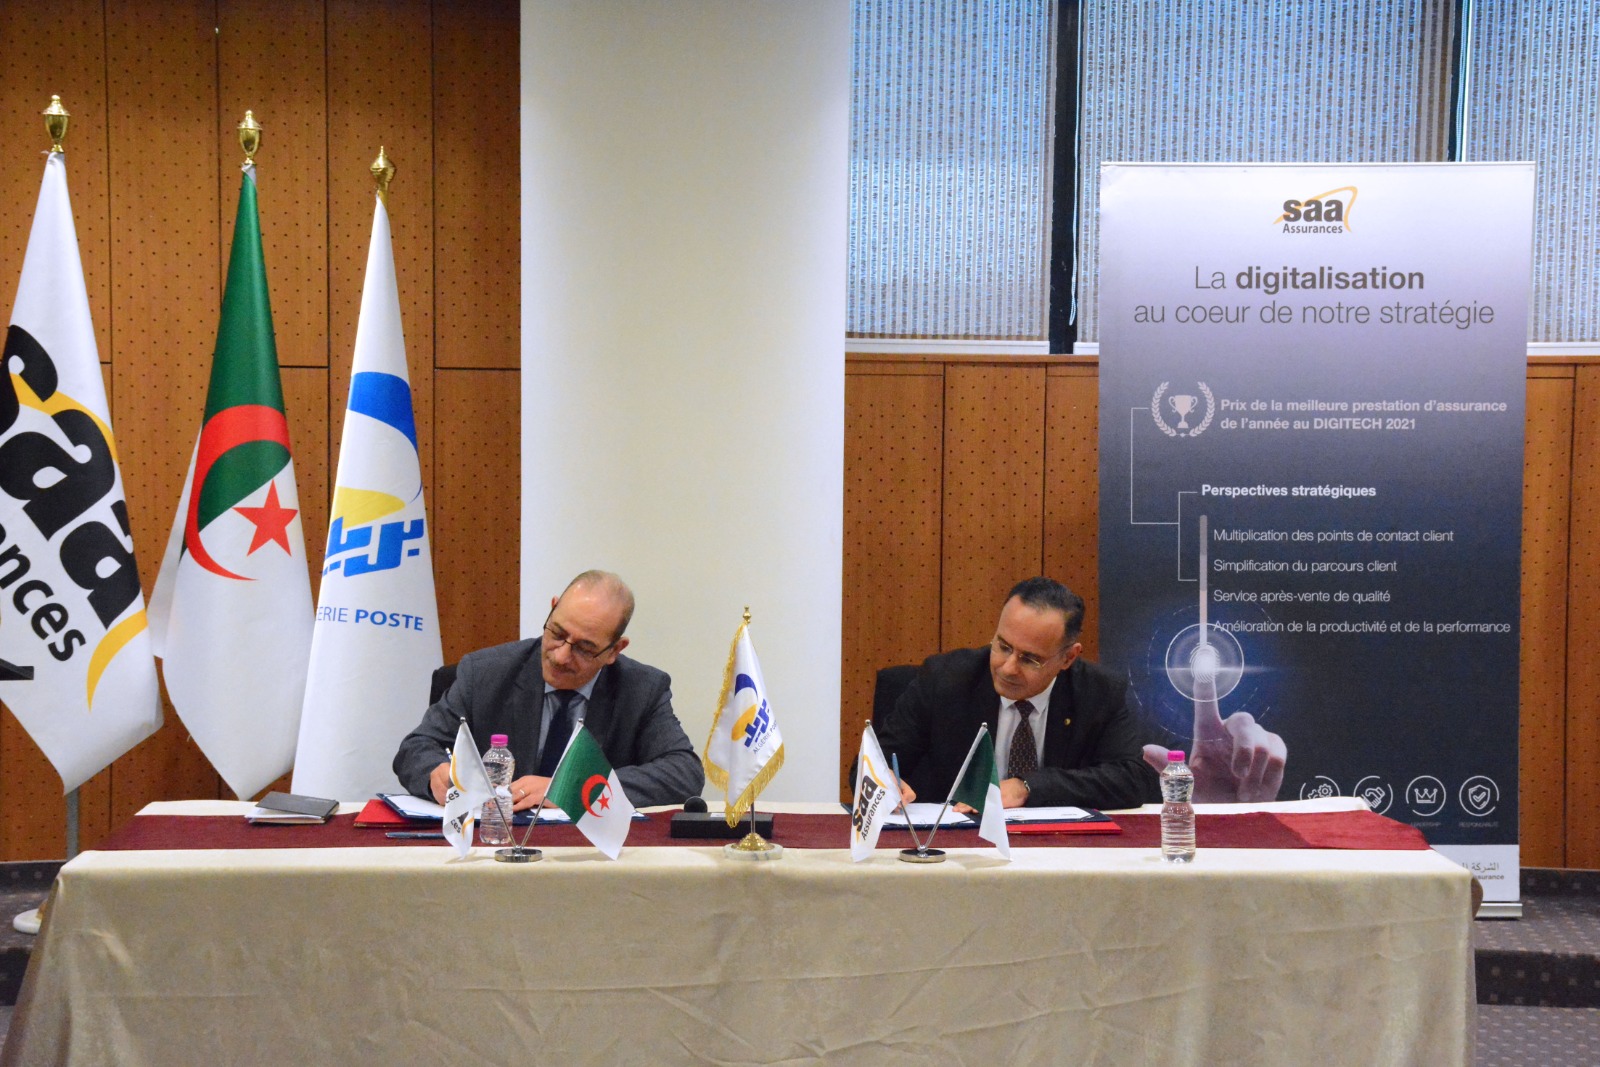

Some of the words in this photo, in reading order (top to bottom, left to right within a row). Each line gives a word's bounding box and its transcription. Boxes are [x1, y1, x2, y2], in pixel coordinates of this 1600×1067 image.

[1283, 199, 1343, 222] saa
[1283, 223, 1343, 234] Assurances
[1195, 266, 1226, 290] La
[1235, 266, 1425, 296] digitalisation
[1133, 304, 1165, 324] au
[1174, 304, 1250, 324] coeur
[1259, 300, 1293, 324] de
[1302, 302, 1371, 324] notre
[1379, 300, 1495, 330] stratégie
[1220, 399, 1247, 411] Prix
[1250, 399, 1268, 411] de
[1271, 399, 1283, 411] la
[1286, 399, 1349, 411] meilleure
[1352, 399, 1420, 414] prestation
[1424, 399, 1508, 412] d'assurance
[1220, 418, 1238, 430] de
[1241, 418, 1290, 430] l'année
[1293, 420, 1310, 430] au
[1313, 418, 1383, 430] DIGITECH
[1386, 418, 1416, 430] 2021
[1202, 484, 1289, 499] Perspectives
[1291, 484, 1377, 499] stratégiques
[1213, 529, 1289, 544] Multiplication
[1291, 530, 1315, 542] des
[1317, 530, 1354, 544] points
[1356, 530, 1374, 542] de
[1376, 530, 1420, 542] contact
[1422, 530, 1455, 542] client
[1213, 559, 1289, 574] Simplification
[1292, 560, 1308, 572] du
[1311, 562, 1364, 574] parcours
[1367, 560, 1398, 572] client
[1213, 590, 1258, 602] Service
[1260, 590, 1331, 604] après-vente
[1333, 590, 1350, 602] de
[1352, 590, 1391, 604] qualité
[355, 609, 424, 631] POSTE
[1213, 620, 1284, 632] Amélioration
[1287, 621, 1303, 632] de
[1306, 620, 1317, 632] la
[1319, 620, 1388, 635] productivité
[1390, 621, 1402, 632] et
[1404, 620, 1421, 632] de
[1423, 620, 1434, 632] la
[1436, 620, 1511, 635] performance
[853, 775, 879, 832] saa
[861, 788, 886, 841] Assurances
